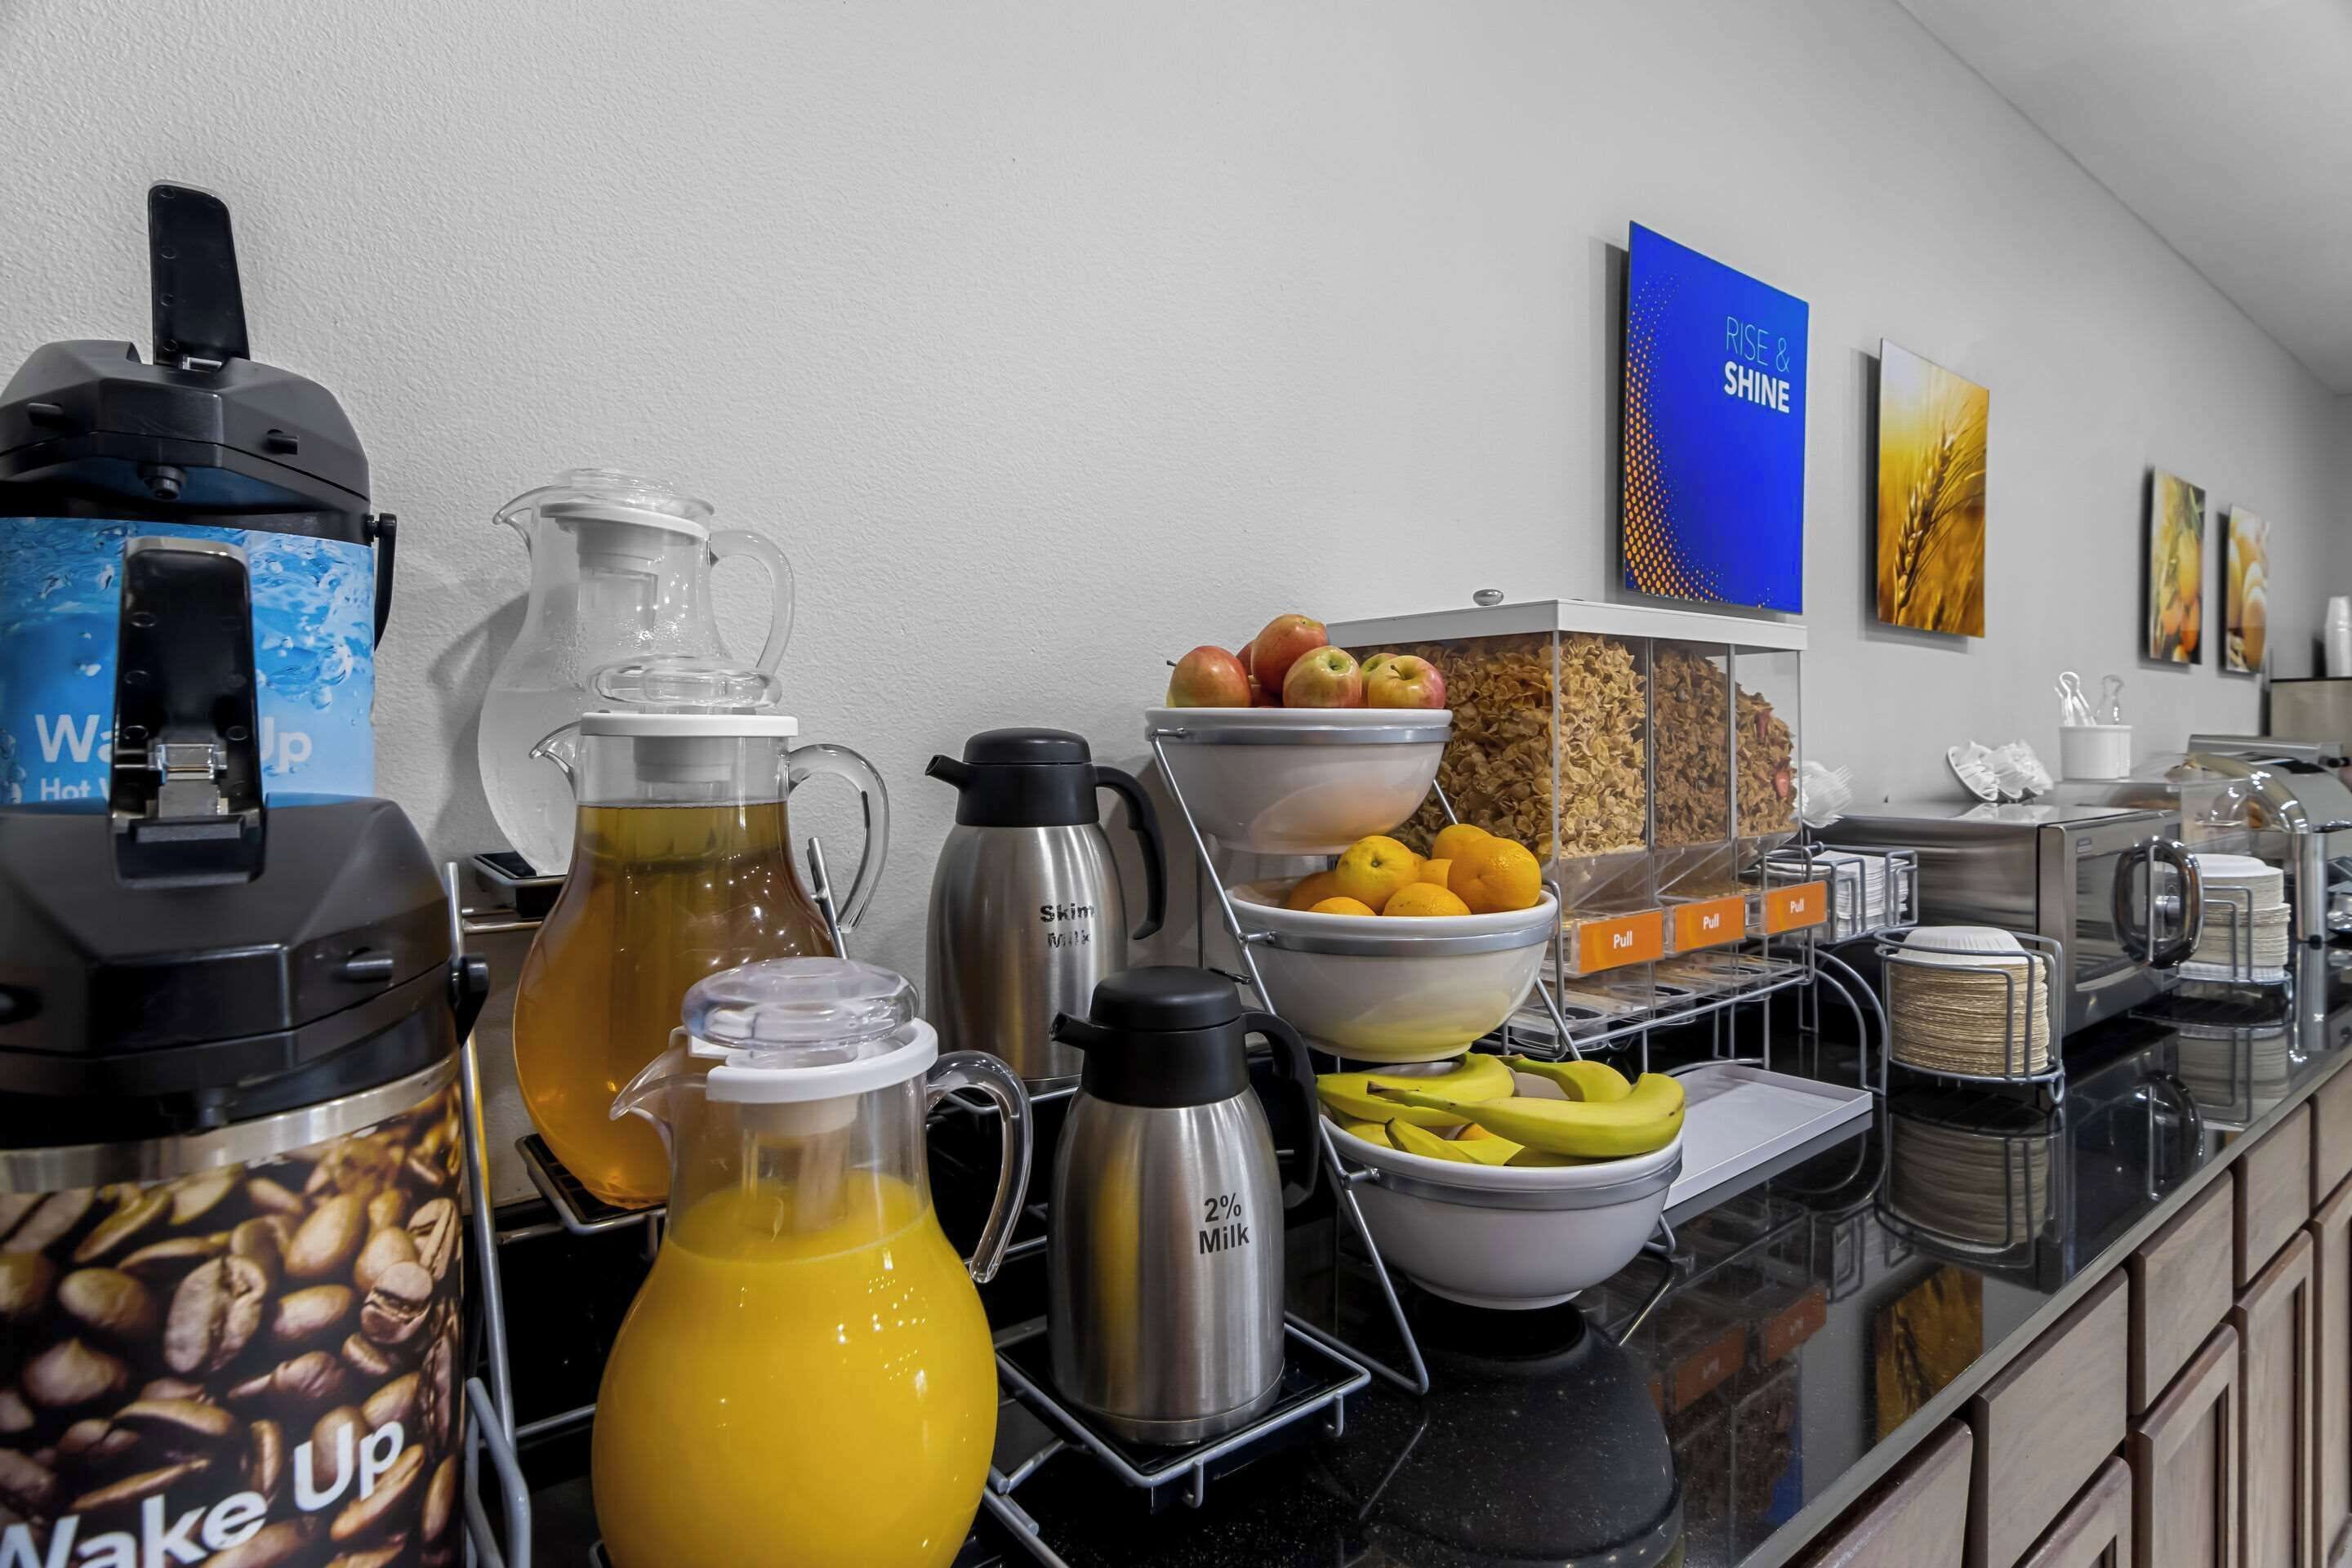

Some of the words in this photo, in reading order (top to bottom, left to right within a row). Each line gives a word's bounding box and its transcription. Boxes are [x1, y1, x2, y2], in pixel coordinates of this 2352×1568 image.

[1726, 315, 1770, 366] RISE
[1775, 336, 1790, 373] &
[1724, 360, 1790, 413] SHINE
[34, 713, 112, 764] Wa
[40, 777, 91, 801] Hot
[1040, 902, 1095, 923] Skim
[1703, 913, 1720, 930] Pull
[1789, 898, 1805, 914] Pull
[1612, 930, 1633, 950] Pull
[1204, 1192, 1242, 1223] 2%
[1199, 1222, 1250, 1254] Milk
[293, 1420, 405, 1512] Up
